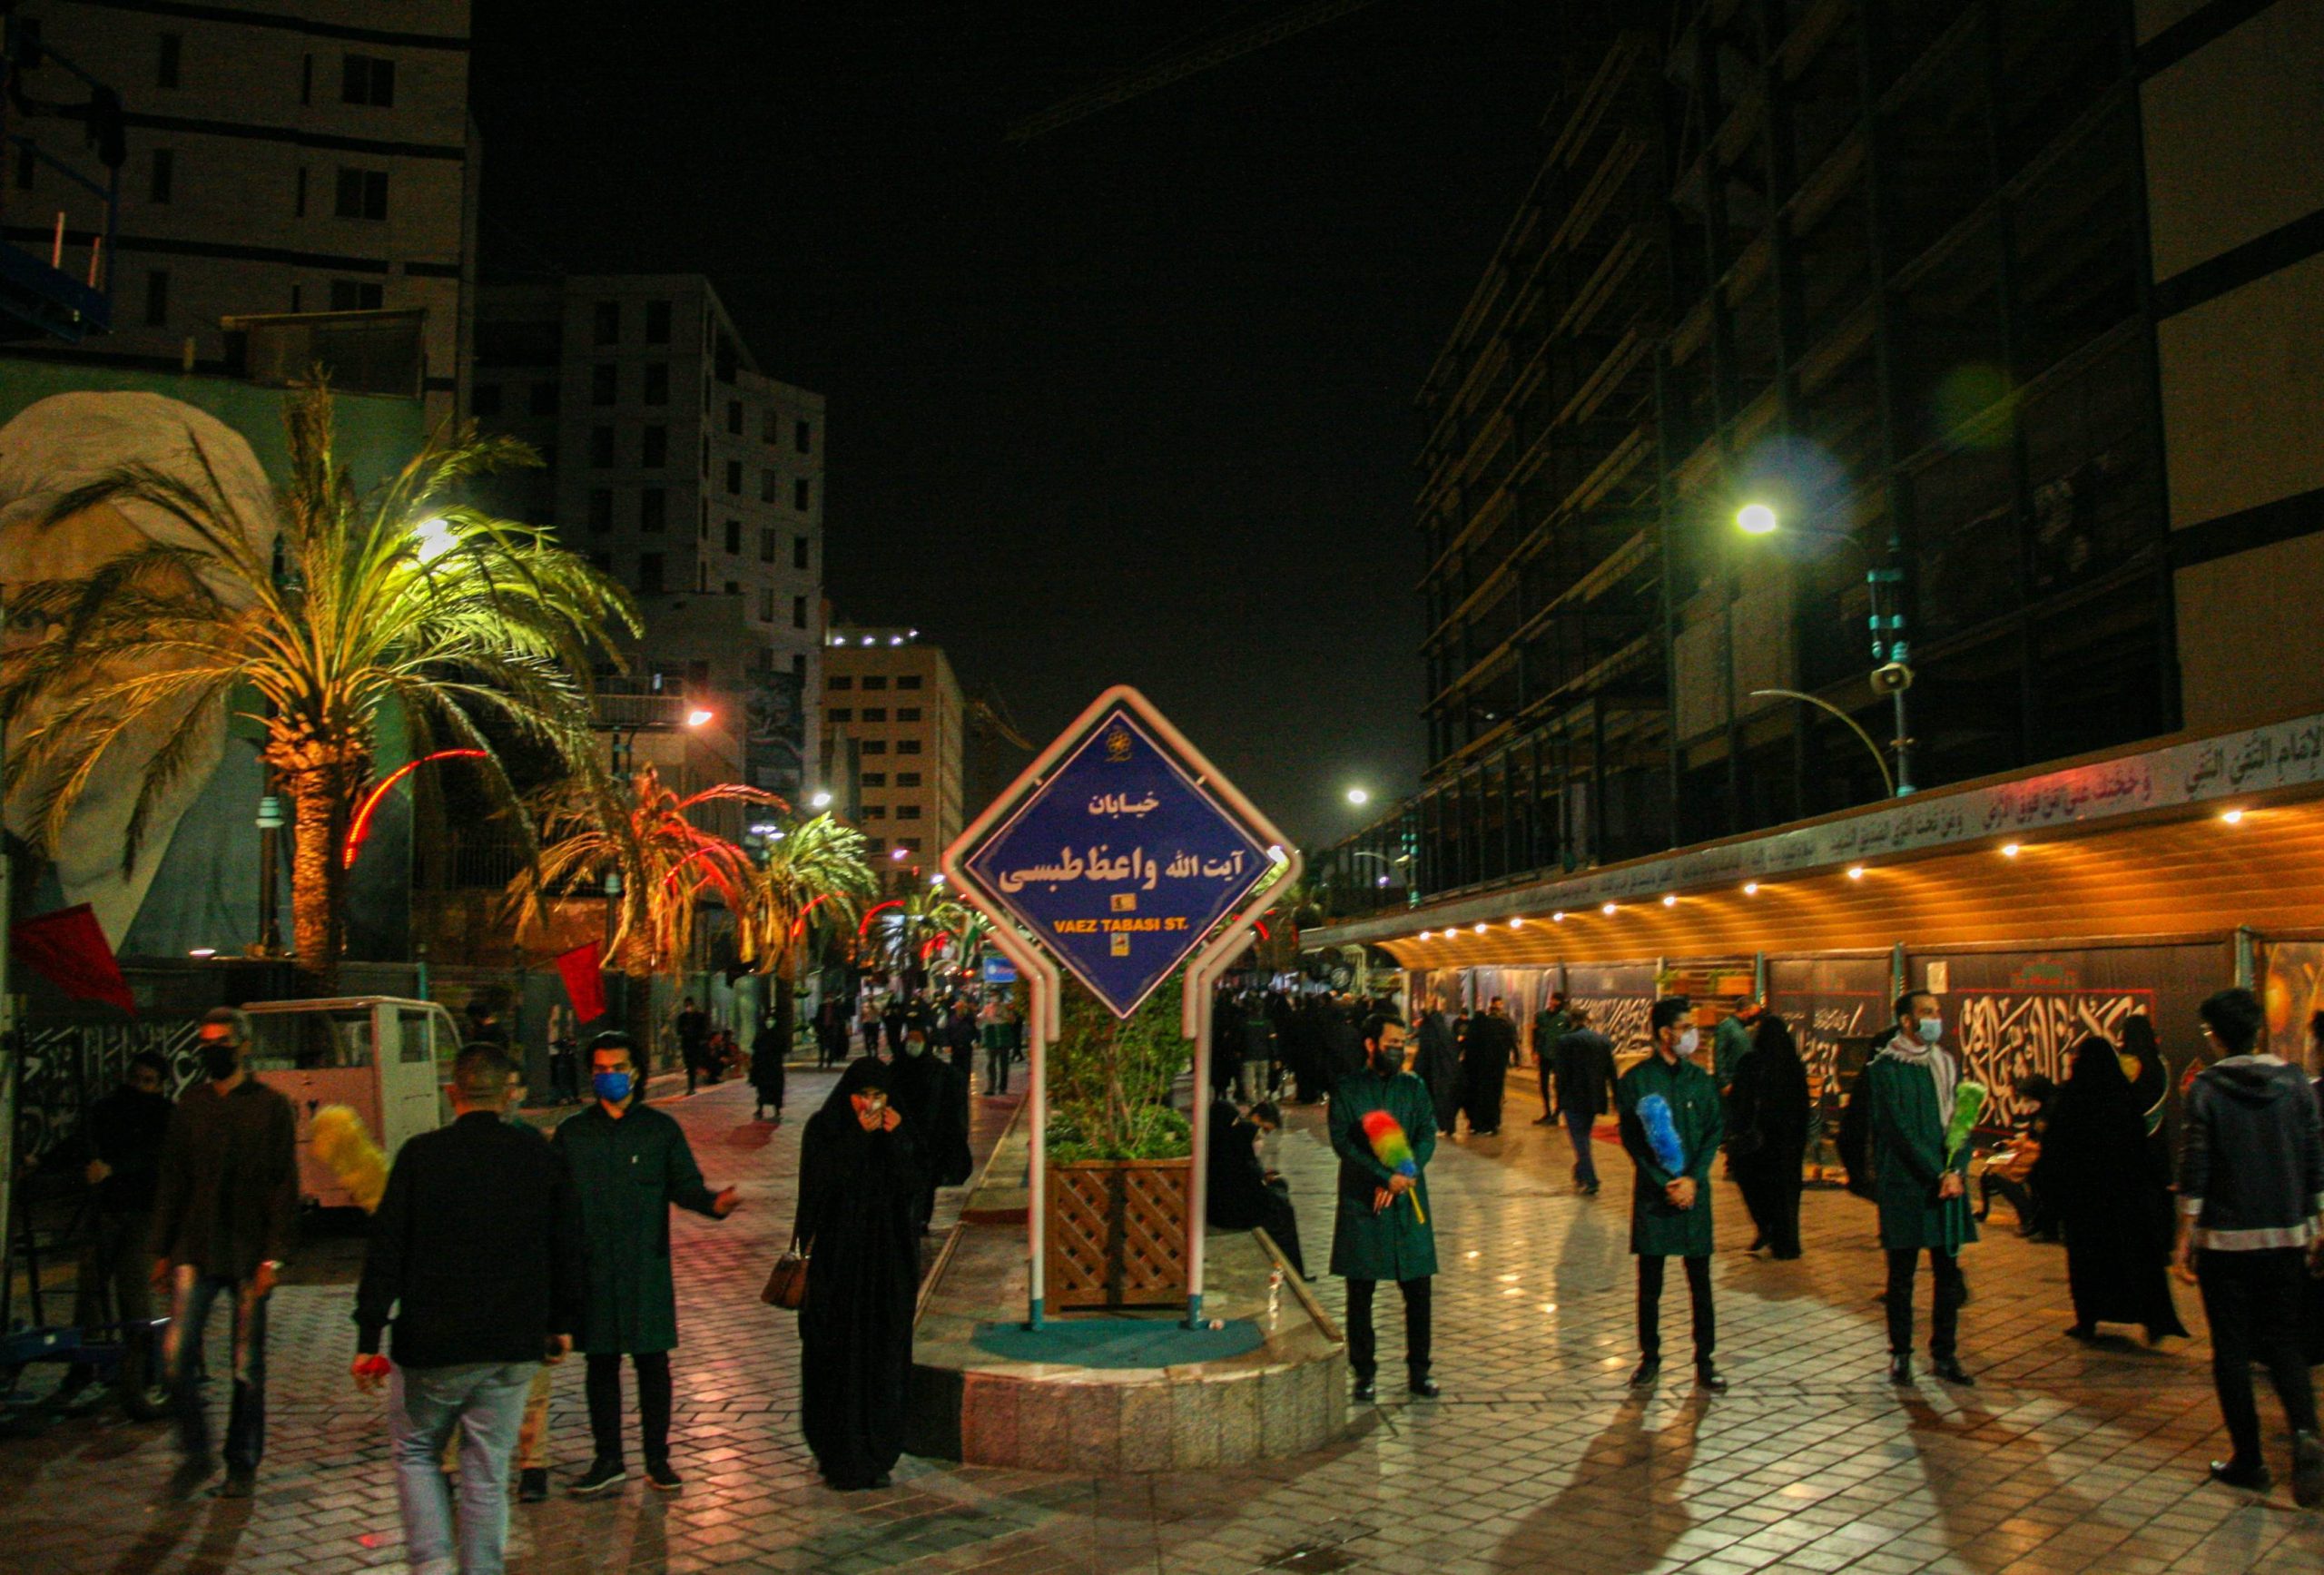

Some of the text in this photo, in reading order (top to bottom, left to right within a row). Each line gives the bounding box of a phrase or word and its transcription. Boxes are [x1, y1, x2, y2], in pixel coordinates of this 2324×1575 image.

[1088, 791, 1159, 819] خیابان
[1000, 843, 1246, 893] آیت الله واعظ طبسی
[1053, 917, 1189, 933] VAEZ TABASI ST.
